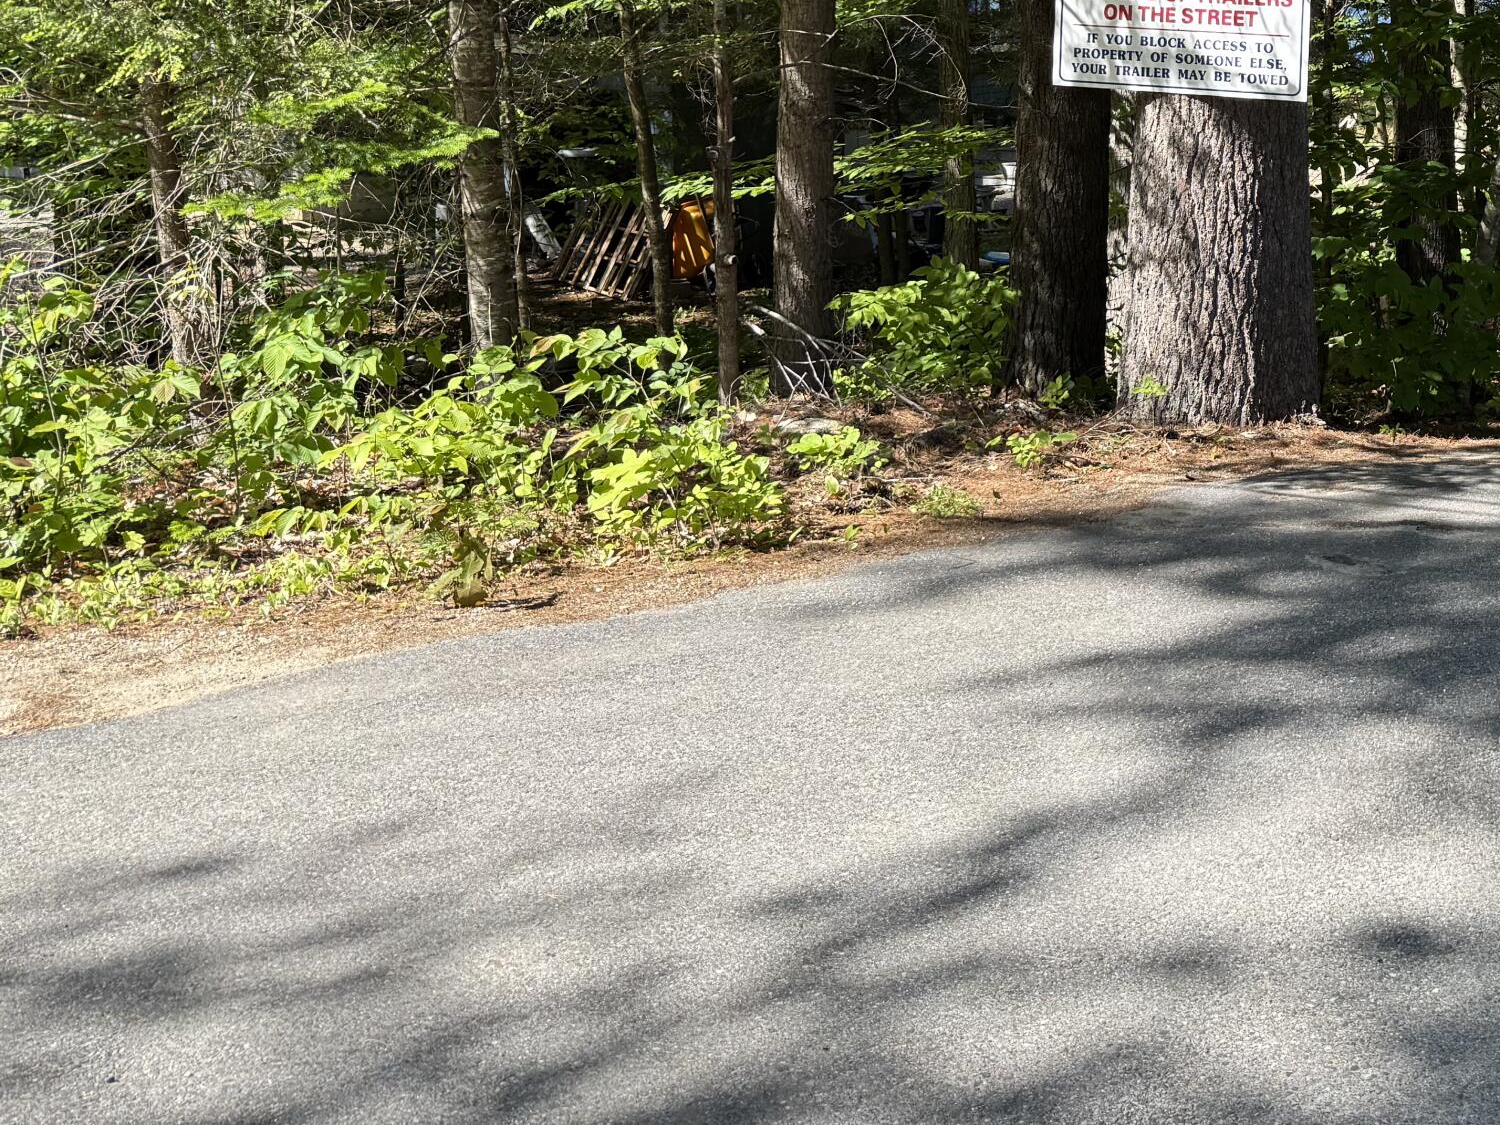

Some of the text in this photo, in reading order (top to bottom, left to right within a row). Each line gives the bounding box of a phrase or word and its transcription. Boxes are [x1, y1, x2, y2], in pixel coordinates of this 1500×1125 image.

[1103, 4, 1258, 27] ON THE STREET
[1086, 33, 1274, 53] IF YOU BLOCK ACCESS TO
[1073, 47, 1287, 72] PROPERTY OF SOMEONE ELSE,
[1071, 62, 1289, 86] YOUR TRAILER MAY BE TOWED
